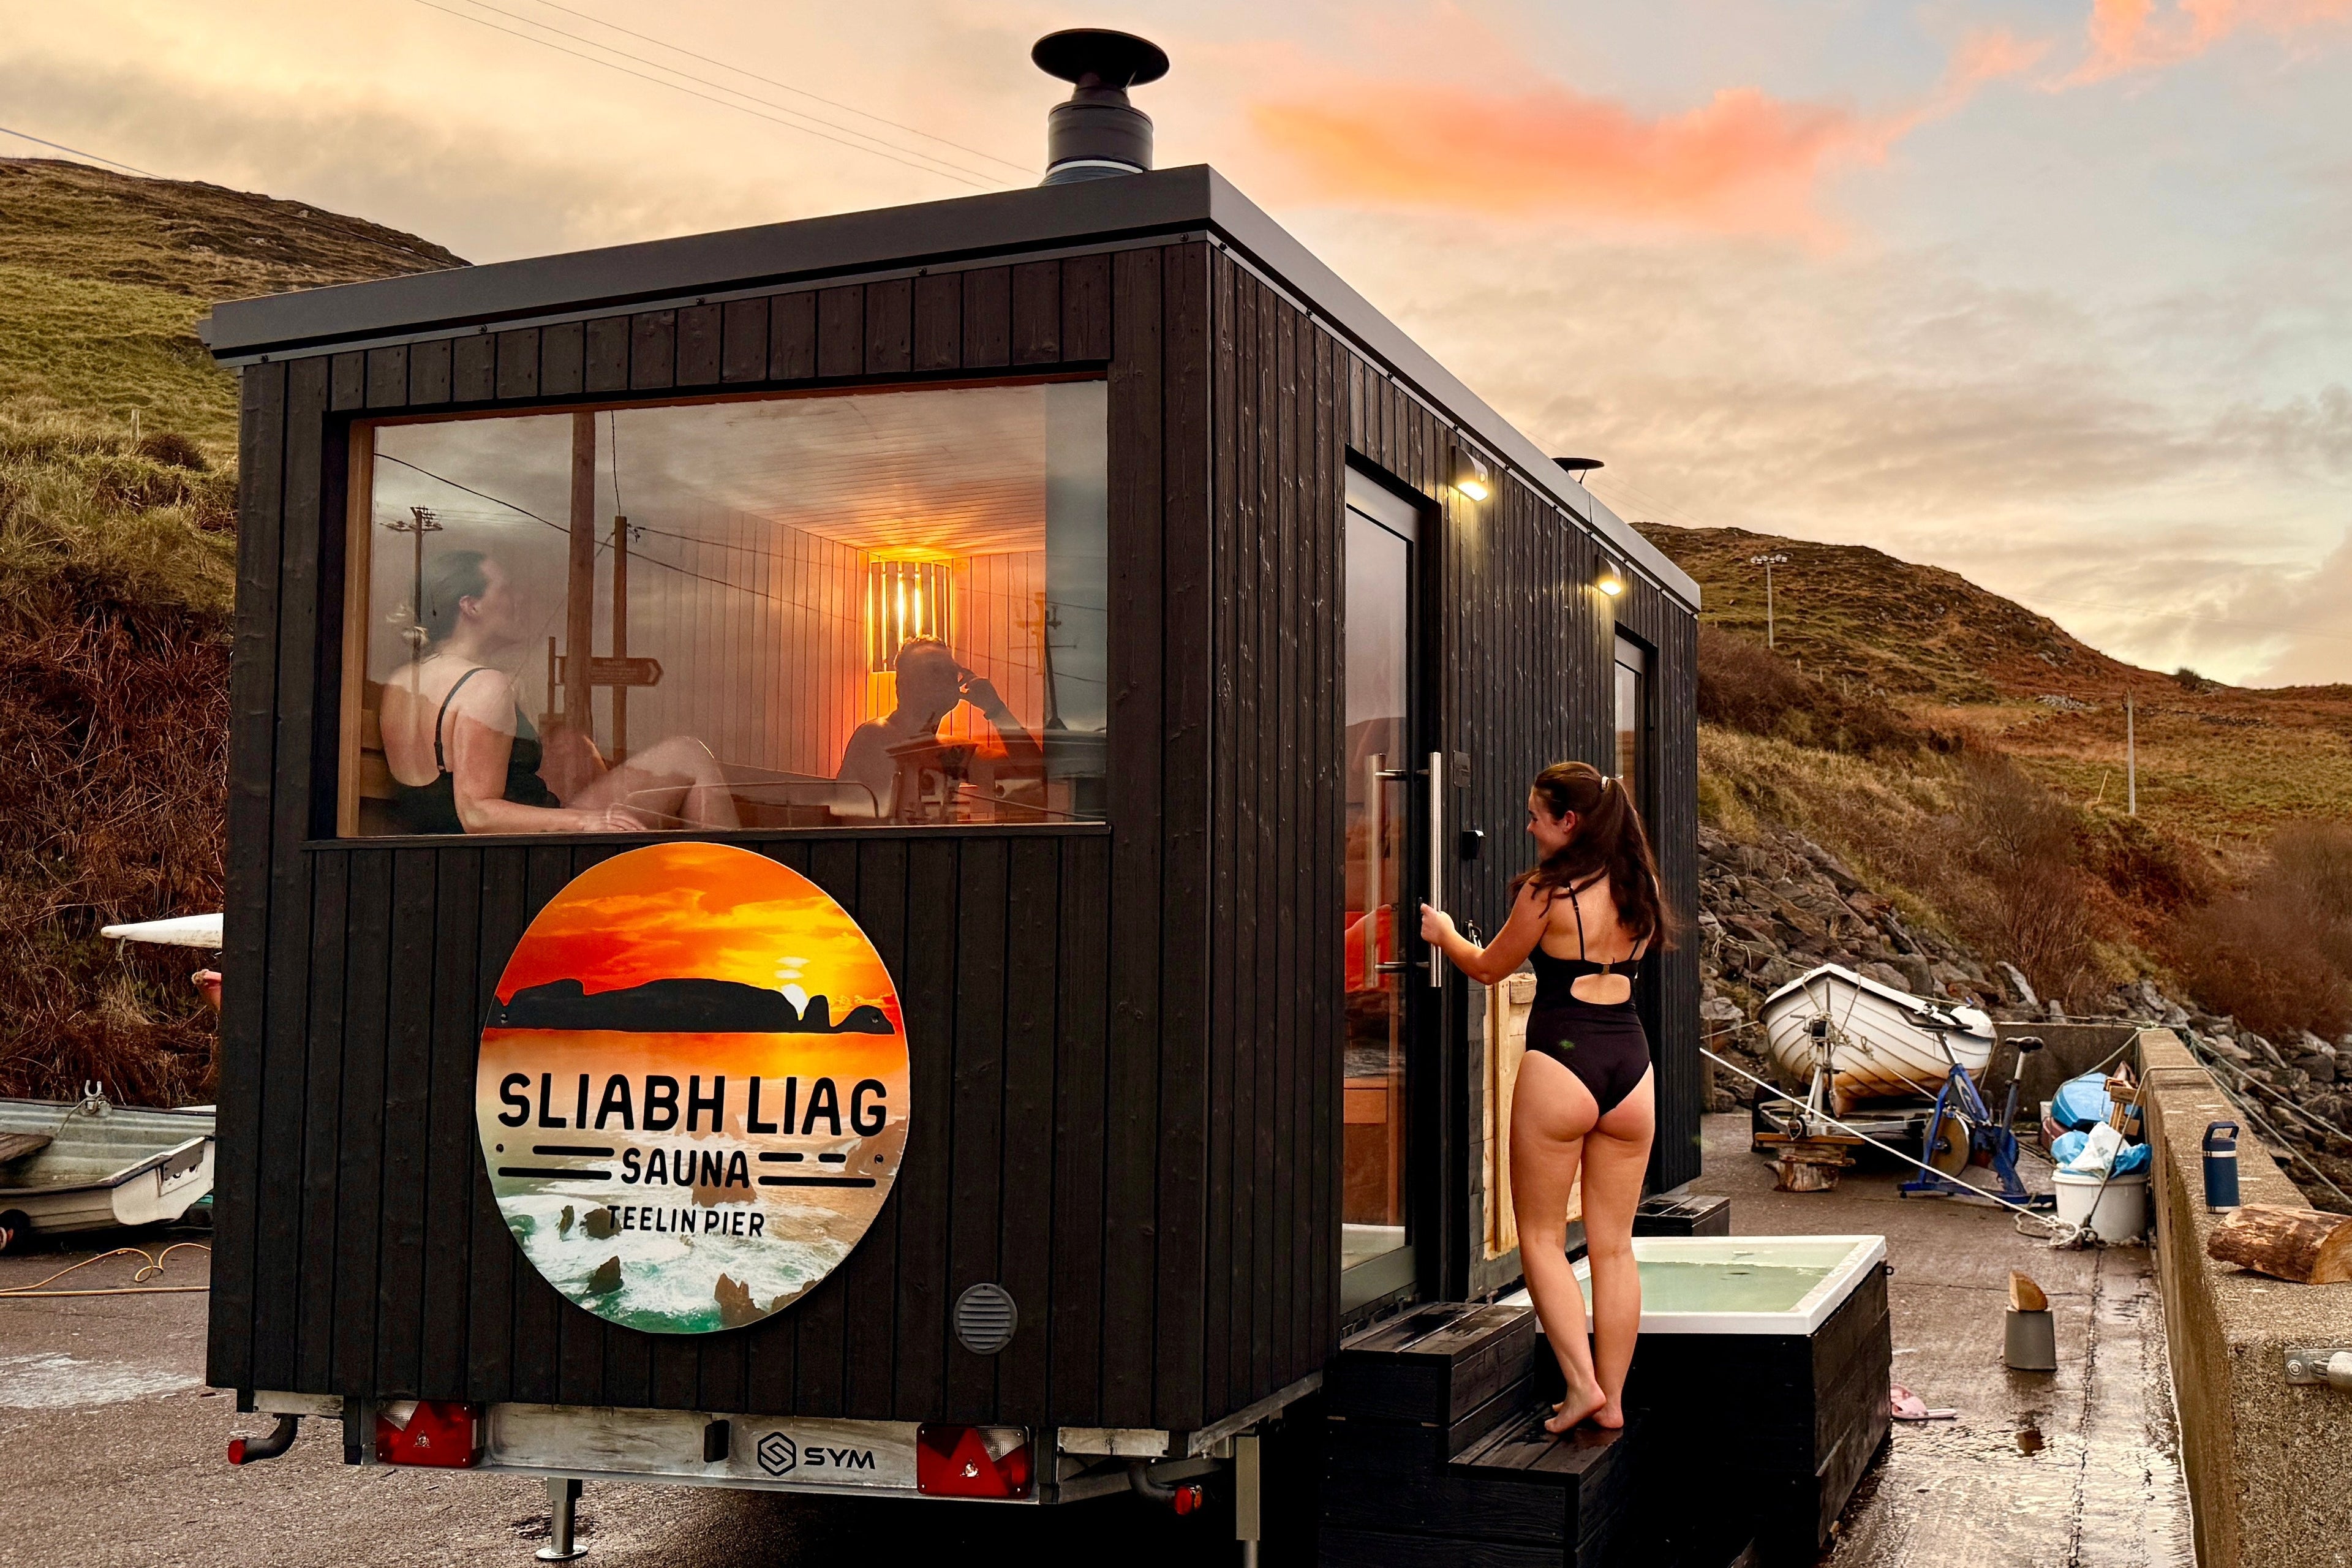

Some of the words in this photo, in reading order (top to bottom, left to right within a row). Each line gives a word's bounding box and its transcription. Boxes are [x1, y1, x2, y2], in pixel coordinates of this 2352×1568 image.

[497, 1072, 726, 1133] SLIABH
[746, 1076, 888, 1137] LIAG
[620, 1147, 750, 1189] SAUNA
[607, 1204, 697, 1234] TEELIN
[704, 1210, 765, 1237] PIER
[803, 1446, 876, 1470] SYM
